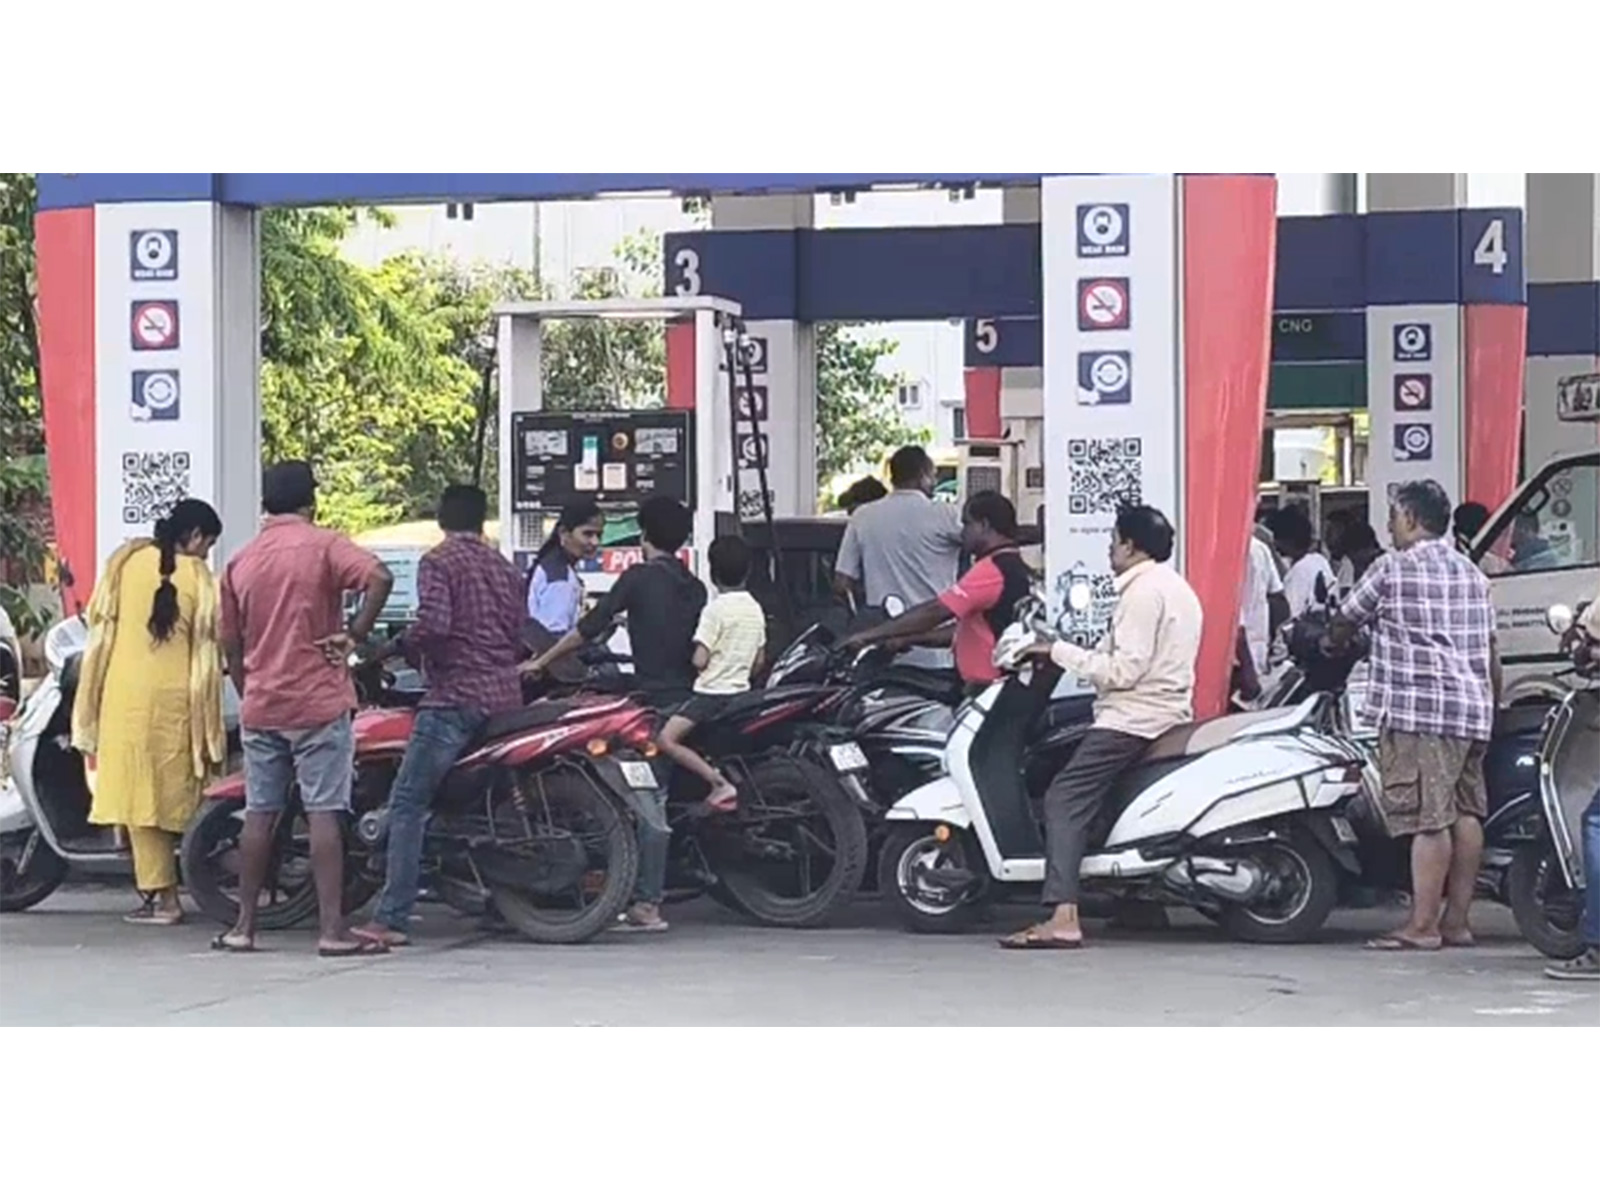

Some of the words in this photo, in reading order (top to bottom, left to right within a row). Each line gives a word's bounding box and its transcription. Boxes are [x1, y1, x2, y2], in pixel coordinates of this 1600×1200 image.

[1474, 219, 1507, 273] 4
[675, 249, 701, 297] 3
[976, 318, 998, 354] 5
[1278, 318, 1312, 333] CNG
